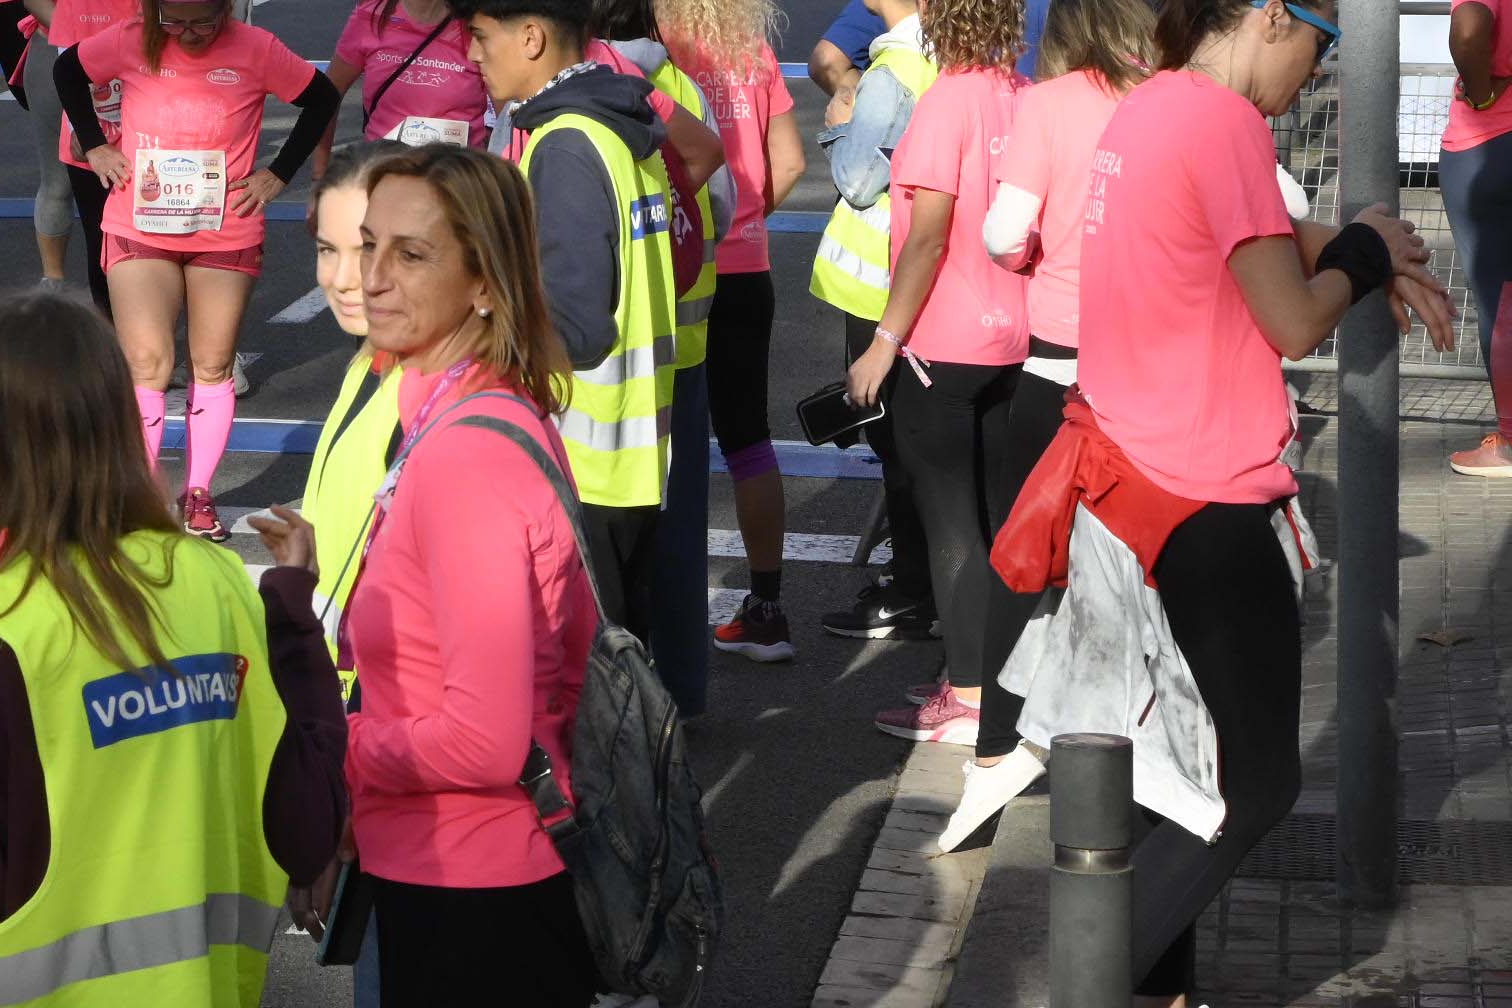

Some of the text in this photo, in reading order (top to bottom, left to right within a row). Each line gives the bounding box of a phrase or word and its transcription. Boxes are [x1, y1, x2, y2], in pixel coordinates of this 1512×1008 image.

[79, 15, 110, 23] OYSHO
[376, 51, 465, 73] Sports Santander
[707, 89, 747, 103] DE LA
[715, 104, 751, 119] UJER
[163, 183, 194, 195] 016
[166, 198, 190, 207] 16864
[1085, 199, 1105, 225] UJER
